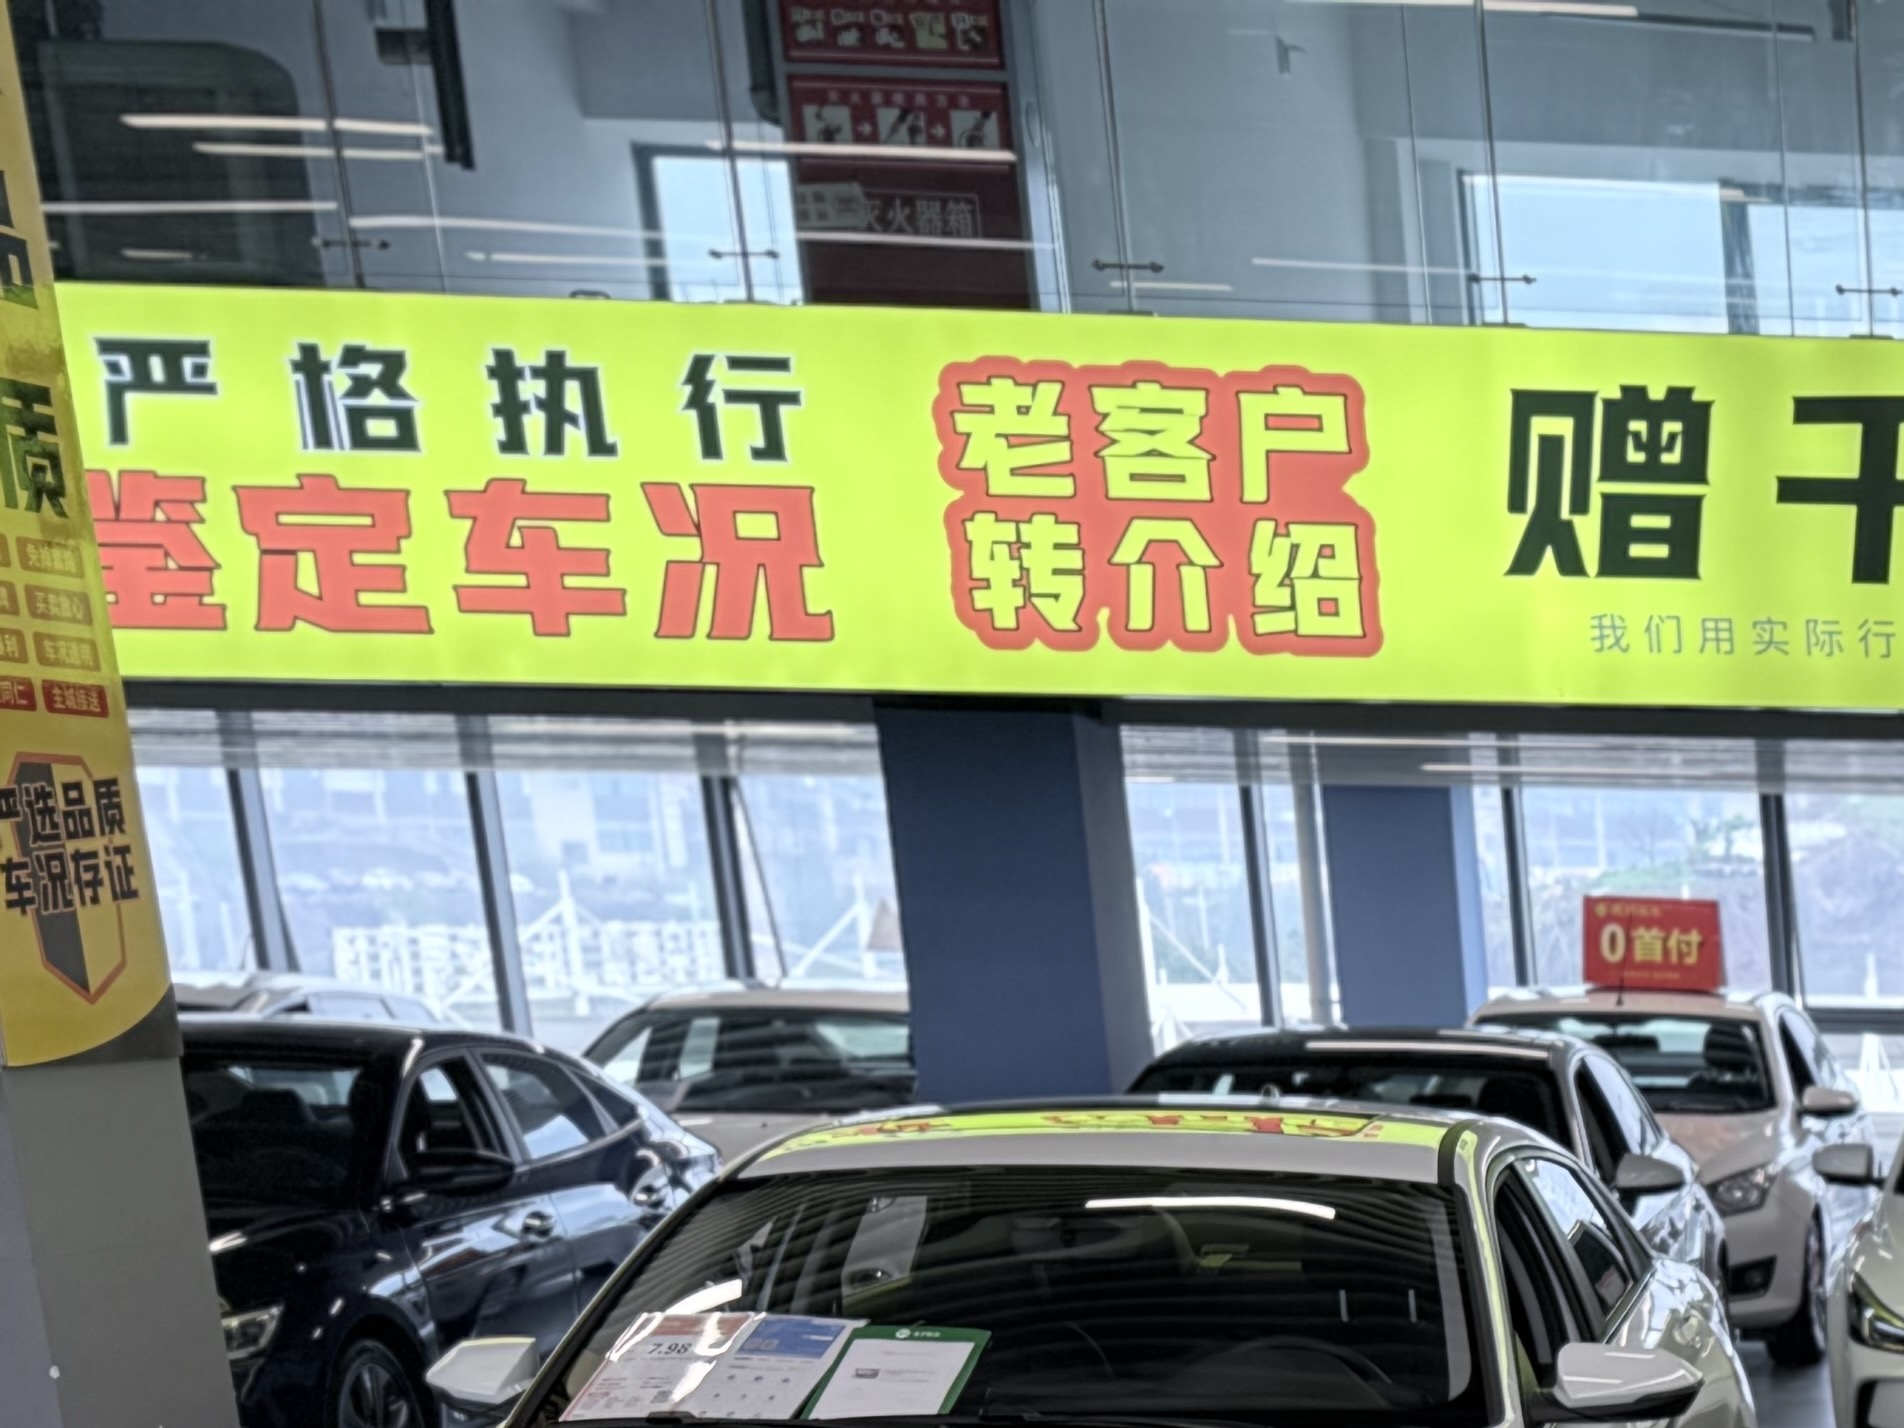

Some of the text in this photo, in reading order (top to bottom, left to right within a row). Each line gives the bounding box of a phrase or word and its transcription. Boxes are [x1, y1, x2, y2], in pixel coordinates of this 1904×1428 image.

[94, 337, 800, 461] 严格执行
[953, 376, 1350, 504] 老客户
[84, 468, 834, 642] 鉴定车况
[963, 511, 1366, 638] 转介绍
[0, 845, 139, 915] 车况存证
[1600, 923, 1703, 965] 0首付
[648, 1342, 692, 1355] 7.98
